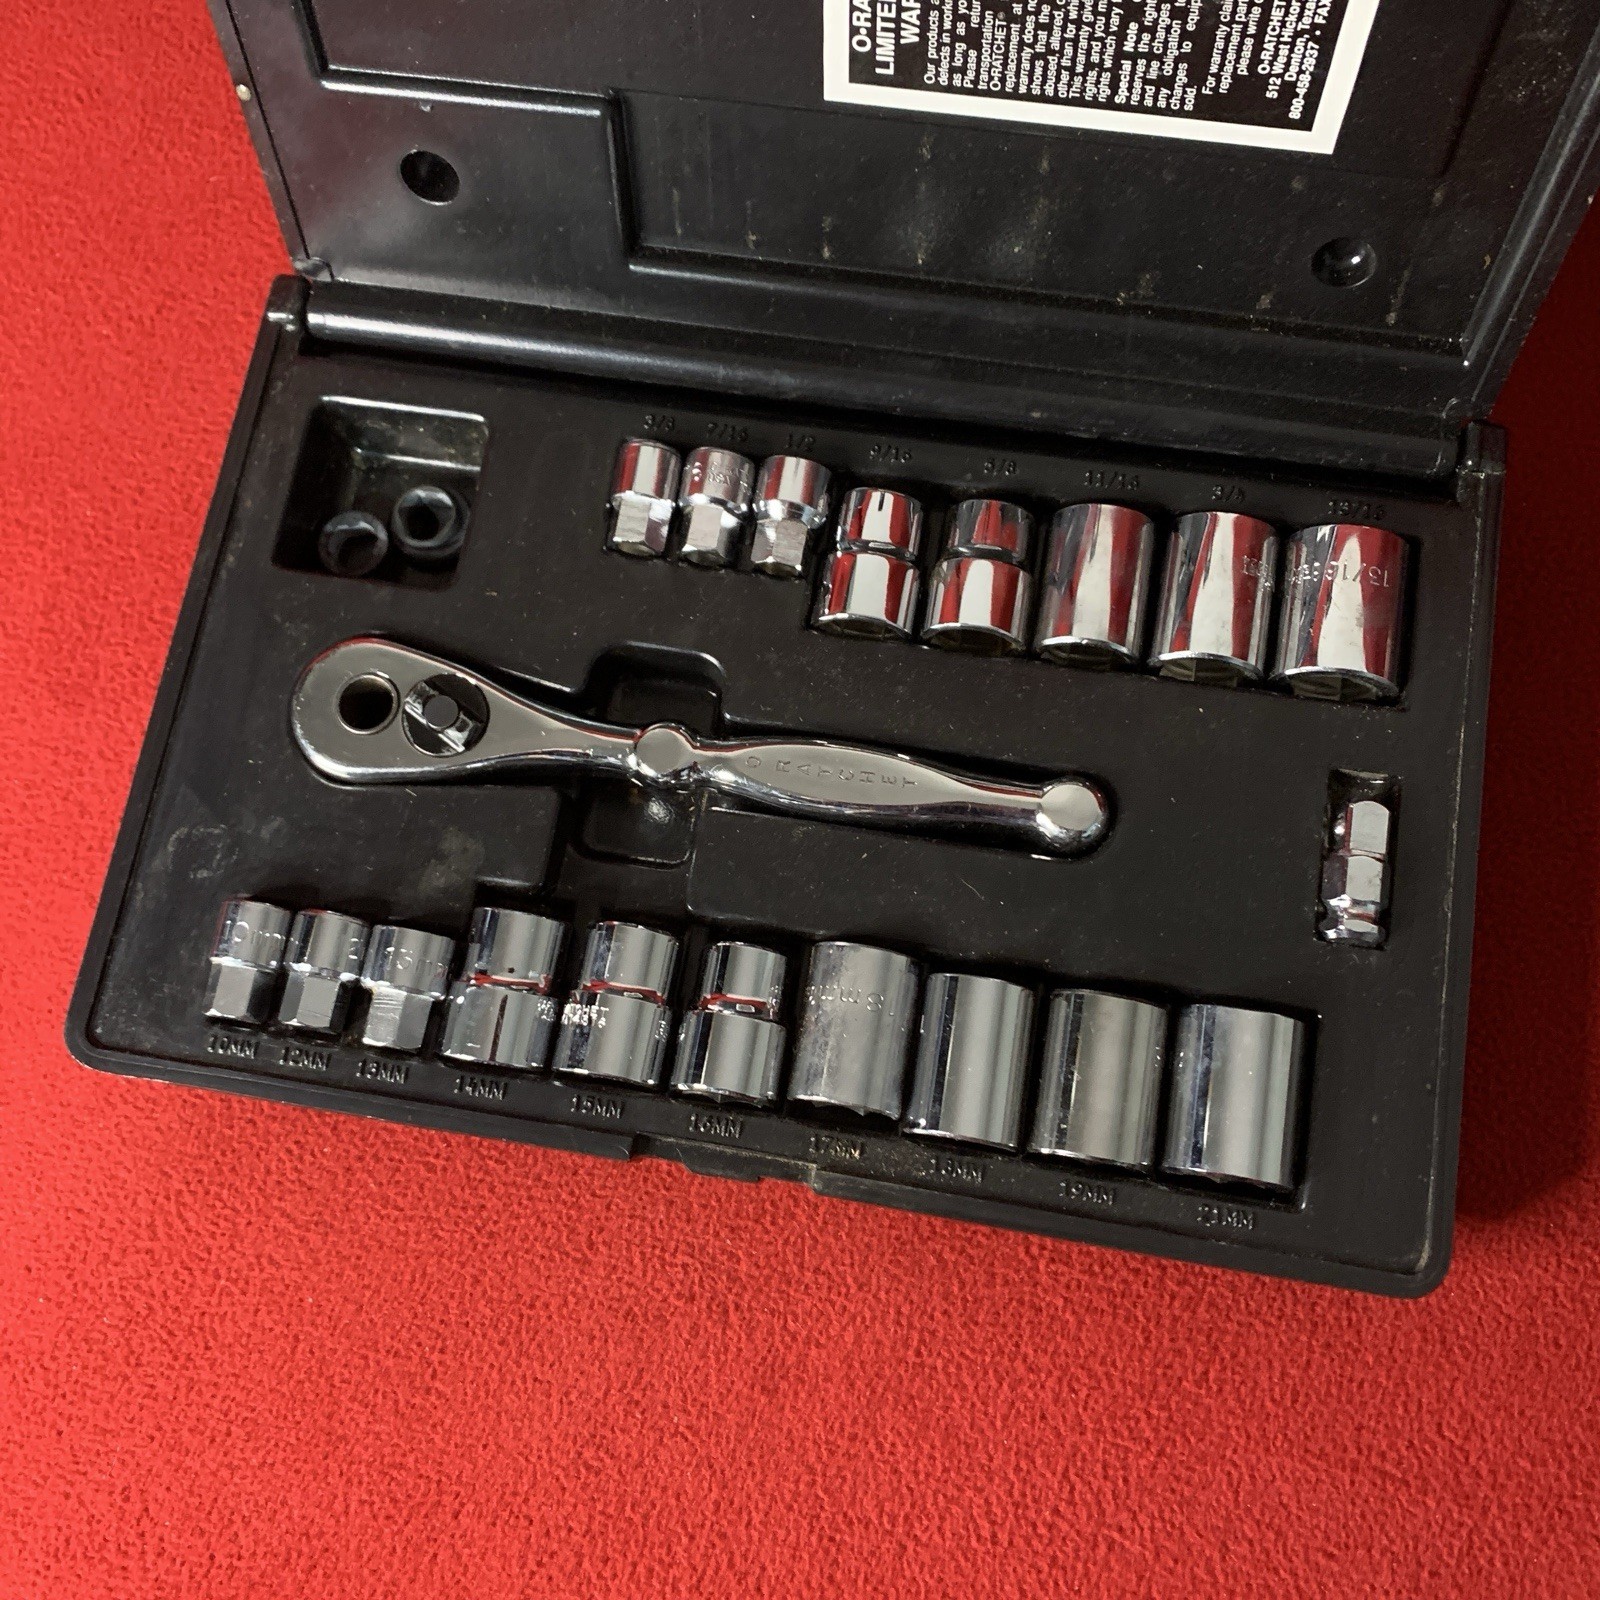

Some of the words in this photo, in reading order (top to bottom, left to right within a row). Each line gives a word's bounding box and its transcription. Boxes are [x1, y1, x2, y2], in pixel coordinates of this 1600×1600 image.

[1012, 3, 1022, 15] at
[1038, 4, 1050, 23] the
[1109, 7, 1124, 31] vary
[875, 0, 897, 75] LIMITE
[926, 10, 939, 59] products
[940, 33, 950, 43] in
[956, 22, 965, 36] as
[1022, 15, 1035, 43] does
[1034, 30, 1048, 53] that
[1049, 8, 1066, 50] altered,
[1063, 22, 1076, 38] for
[1094, 16, 1106, 38] you
[1122, 21, 1139, 52] Note
[1137, 32, 1151, 52] the
[1151, 3, 1171, 54] changes
[1236, 38, 1254, 76] please
[1246, 6, 1262, 35] write
[1284, 34, 1310, 82] Denton,
[1297, 0, 1317, 31] Texa
[952, 42, 967, 67] long
[977, 11, 994, 90] transportation
[1004, 24, 1021, 92] replacement
[1061, 42, 1073, 66] than
[1075, 25, 1092, 73] warranty
[1090, 41, 1102, 63] and
[1102, 35, 1117, 68] which
[1161, 20, 1182, 76] obligation
[1208, 24, 1230, 74] warranty
[1218, 24, 1244, 94] replacement
[1271, 44, 1291, 75] West
[924, 63, 935, 84] Our
[938, 46, 950, 86] defects
[953, 73, 962, 87] as
[963, 49, 977, 88] Please
[1018, 46, 1034, 94] warranty
[1030, 60, 1044, 95] shows
[1043, 53, 1060, 97] abused,
[1130, 58, 1147, 105] reserves
[1145, 60, 1160, 79] line
[1169, 62, 1188, 110] changes
[1179, 41, 1193, 53] to
[1288, 41, 1320, 120] 800-458-2937
[1057, 69, 1070, 98] other
[1069, 75, 1083, 98] This
[1082, 68, 1099, 100] rights,
[1096, 71, 1112, 102] rights
[1114, 60, 1132, 104] Special
[1143, 85, 1156, 107] and
[1156, 87, 1171, 108] any
[1201, 75, 1216, 95] For
[1265, 77, 1282, 99] 512
[1183, 85, 1198, 111] sold.
